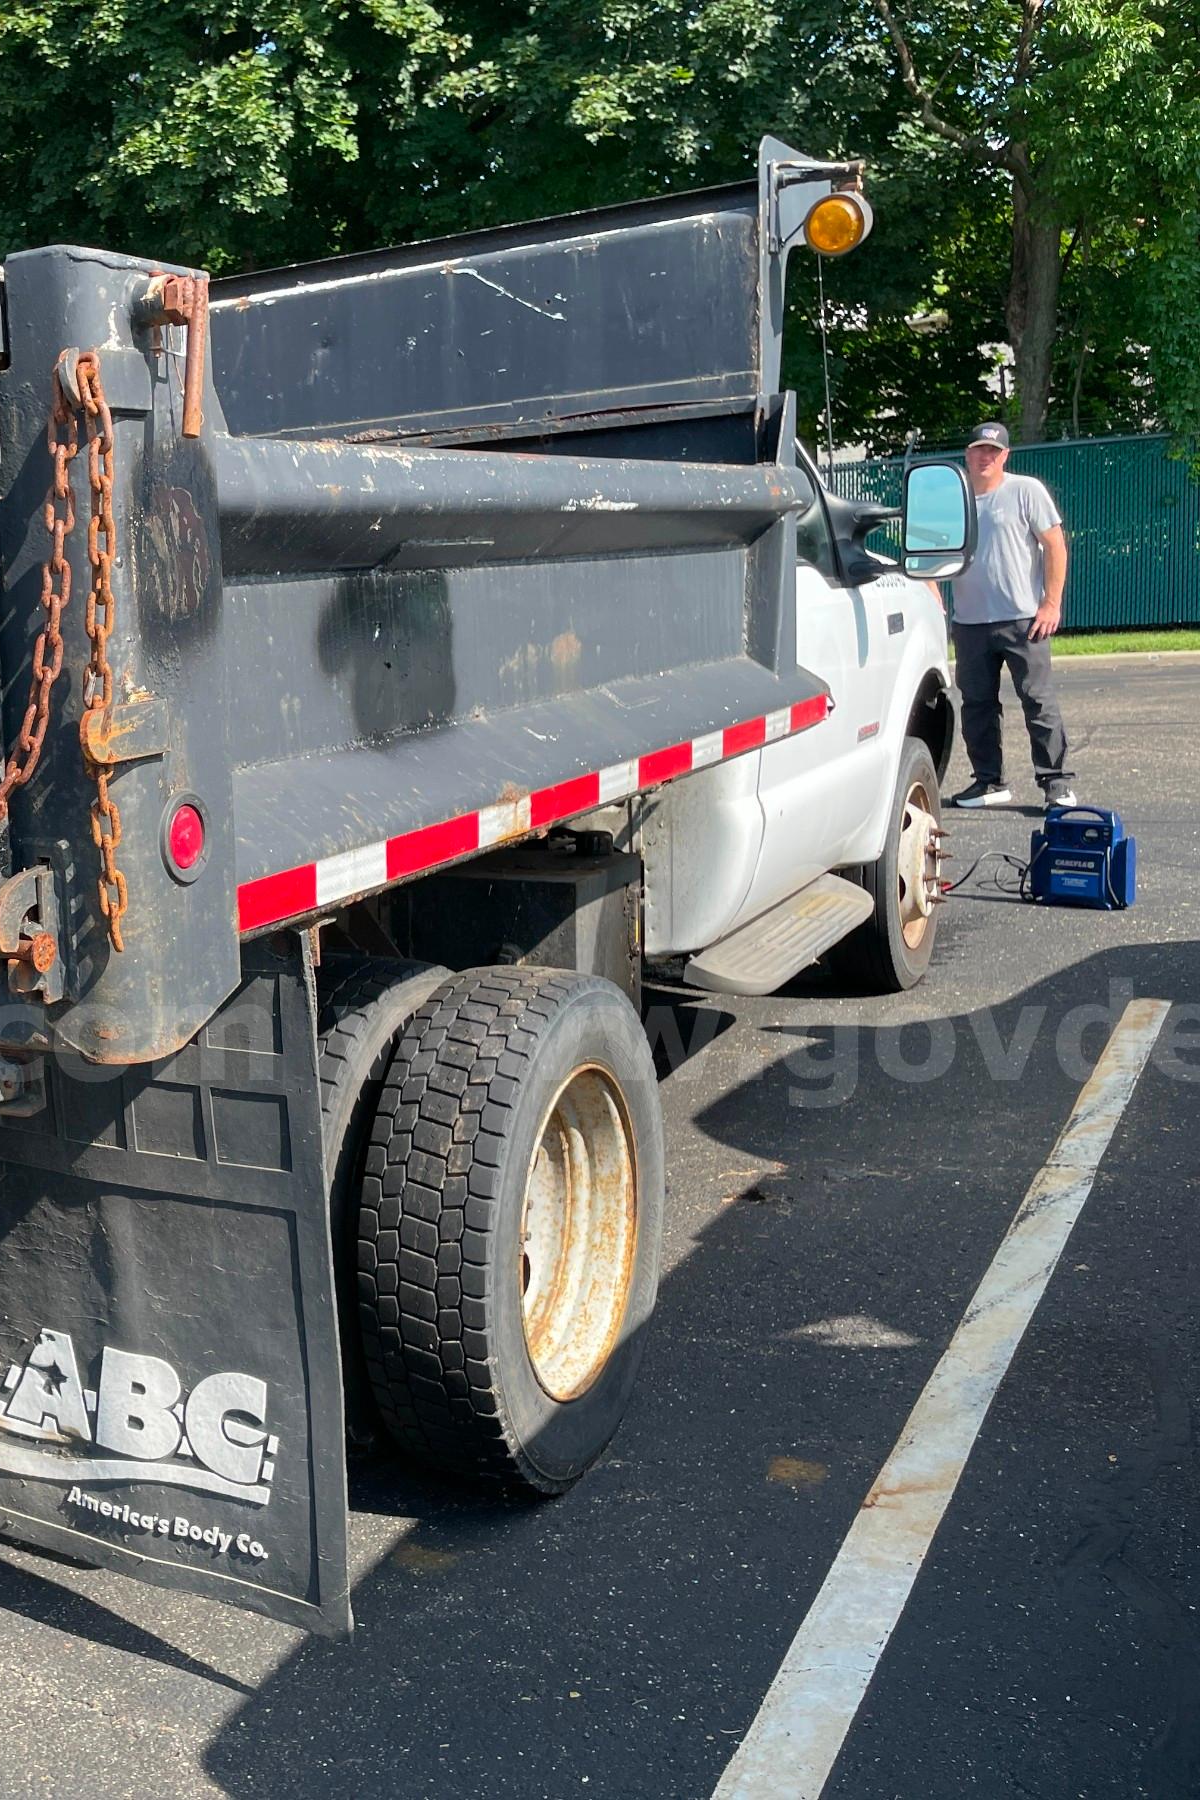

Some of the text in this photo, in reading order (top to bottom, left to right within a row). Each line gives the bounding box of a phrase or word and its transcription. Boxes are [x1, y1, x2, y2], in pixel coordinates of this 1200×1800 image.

[2, 1328, 269, 1483] ABC
[66, 1486, 270, 1560] America's Body Co.
